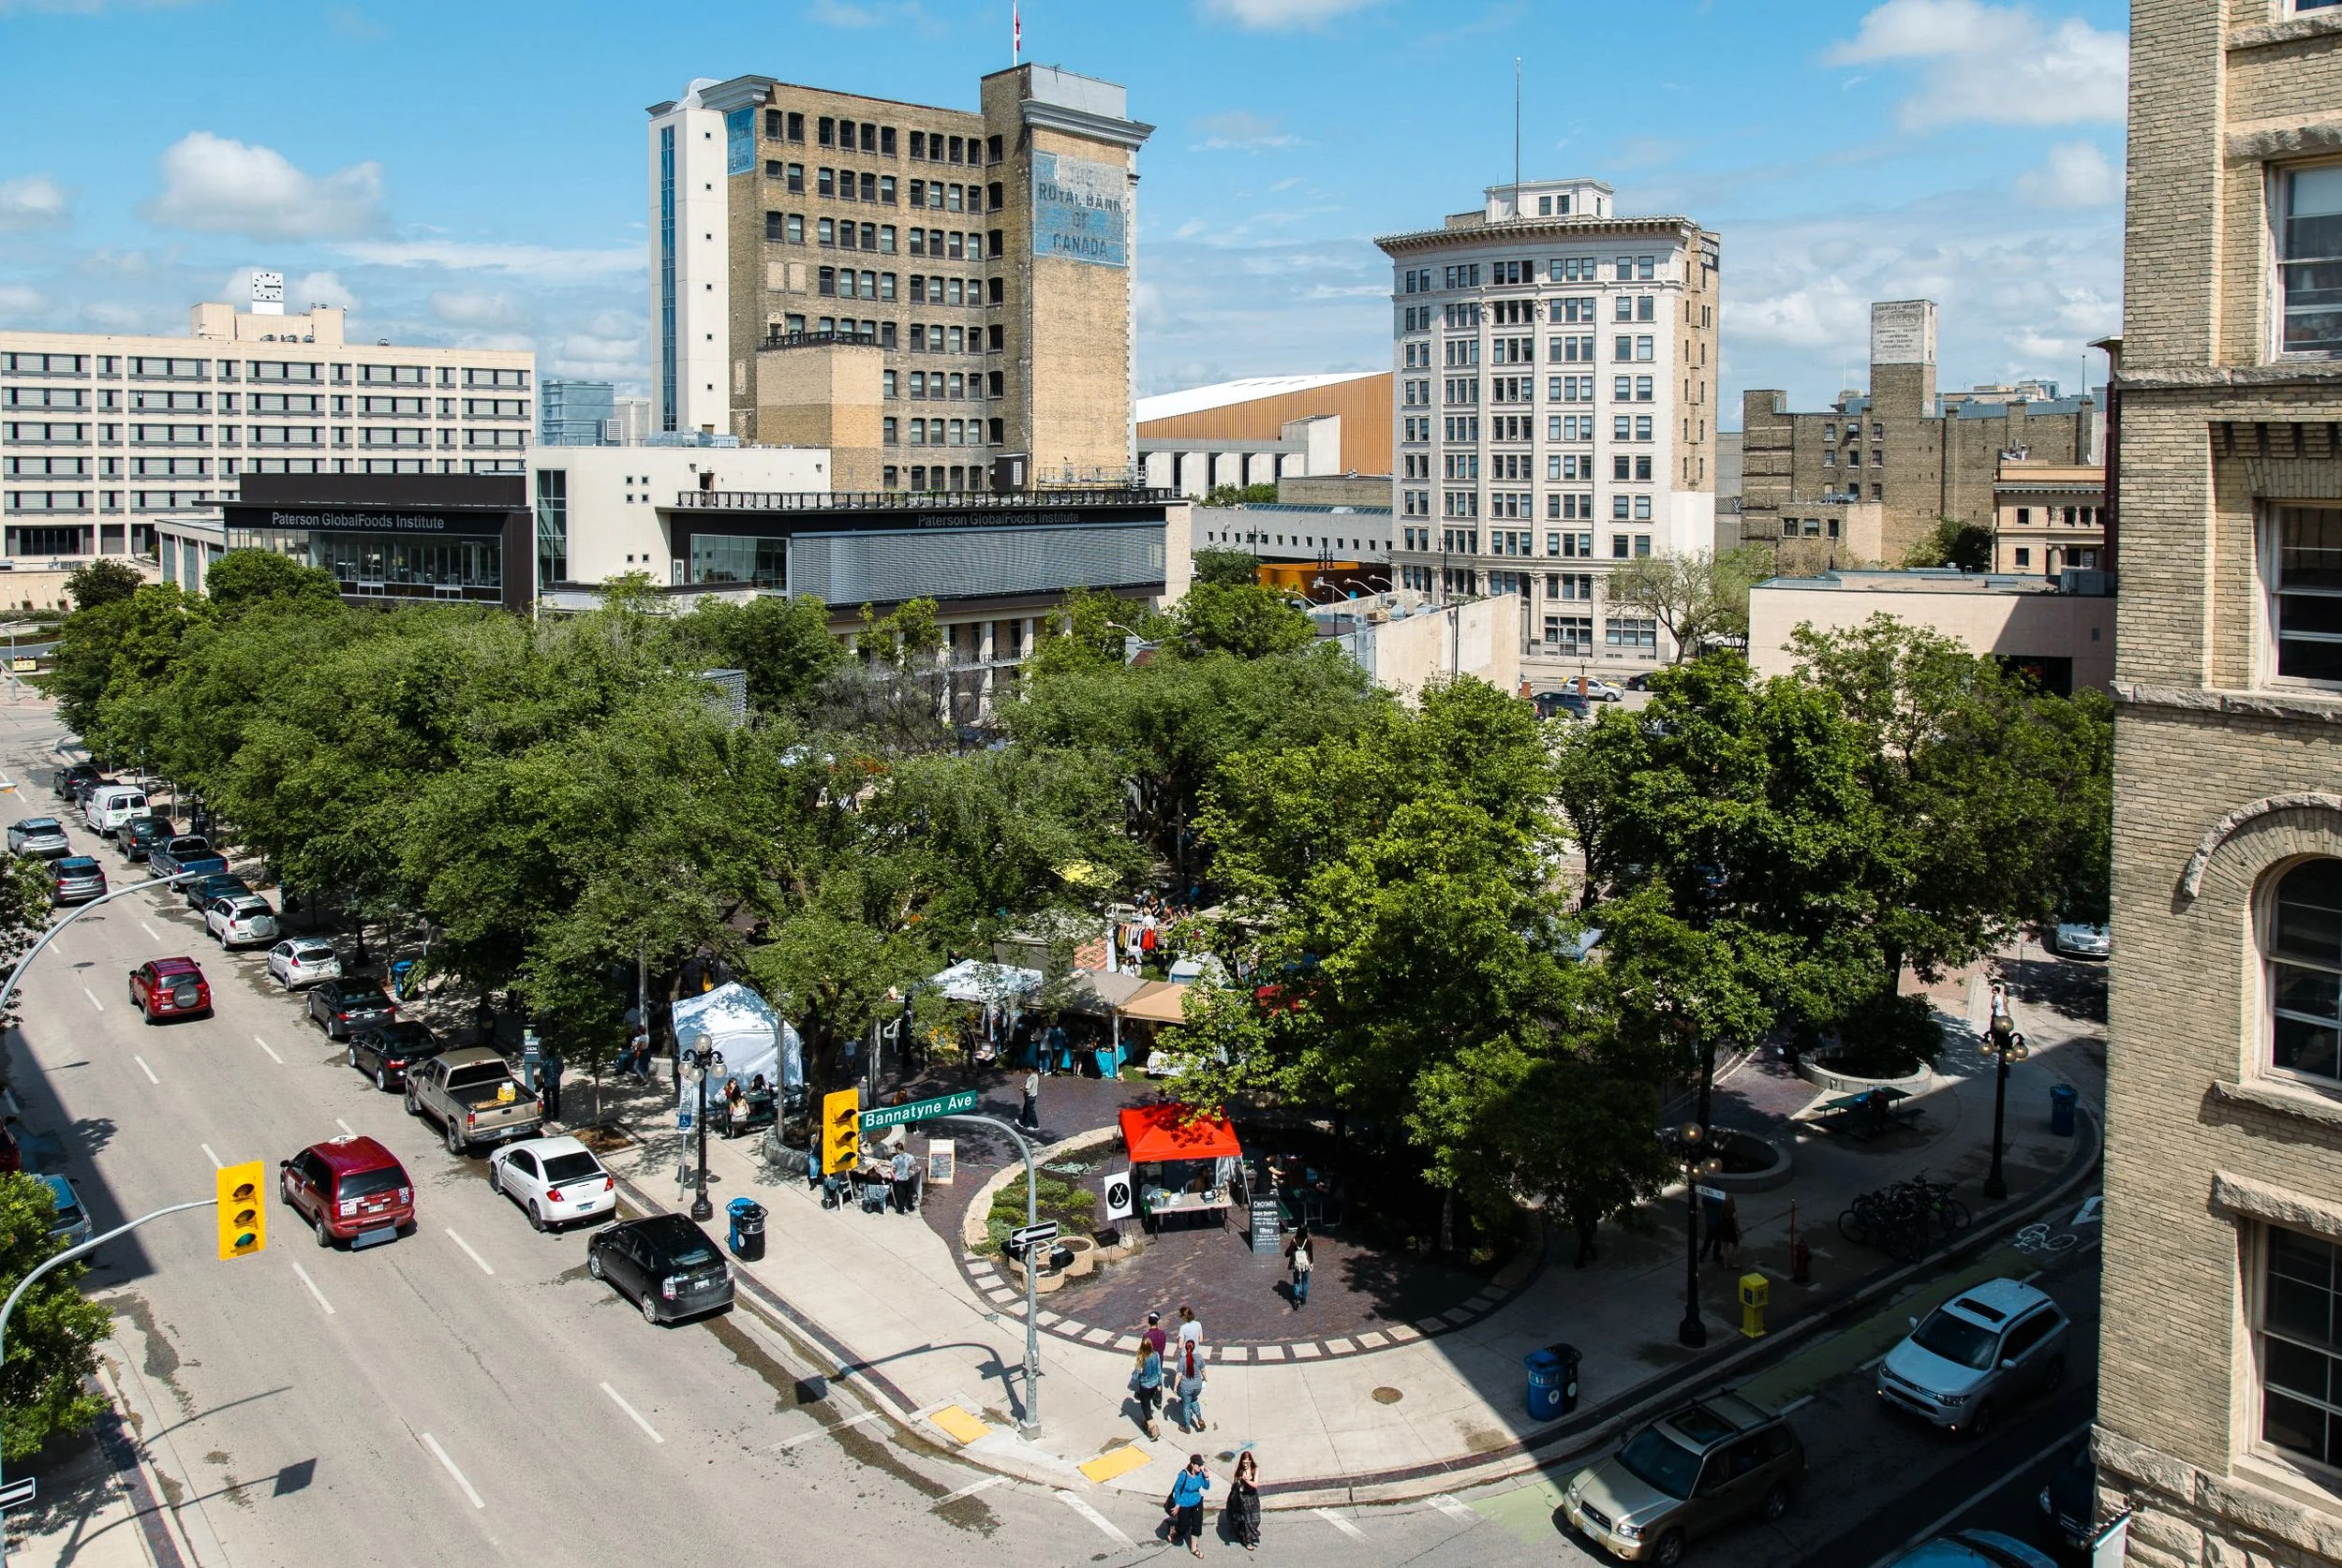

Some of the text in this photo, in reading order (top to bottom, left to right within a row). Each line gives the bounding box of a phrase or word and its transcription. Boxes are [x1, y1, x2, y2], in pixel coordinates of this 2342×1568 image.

[1038, 182, 1122, 213] ROYAL BANK
[1053, 232, 1107, 257] CANADA
[272, 511, 445, 529] Paterson GlobalFoods Institute
[918, 511, 1079, 527] Paterson GlobalFoods Institute
[865, 1096, 972, 1128] Bannatyne Ave
